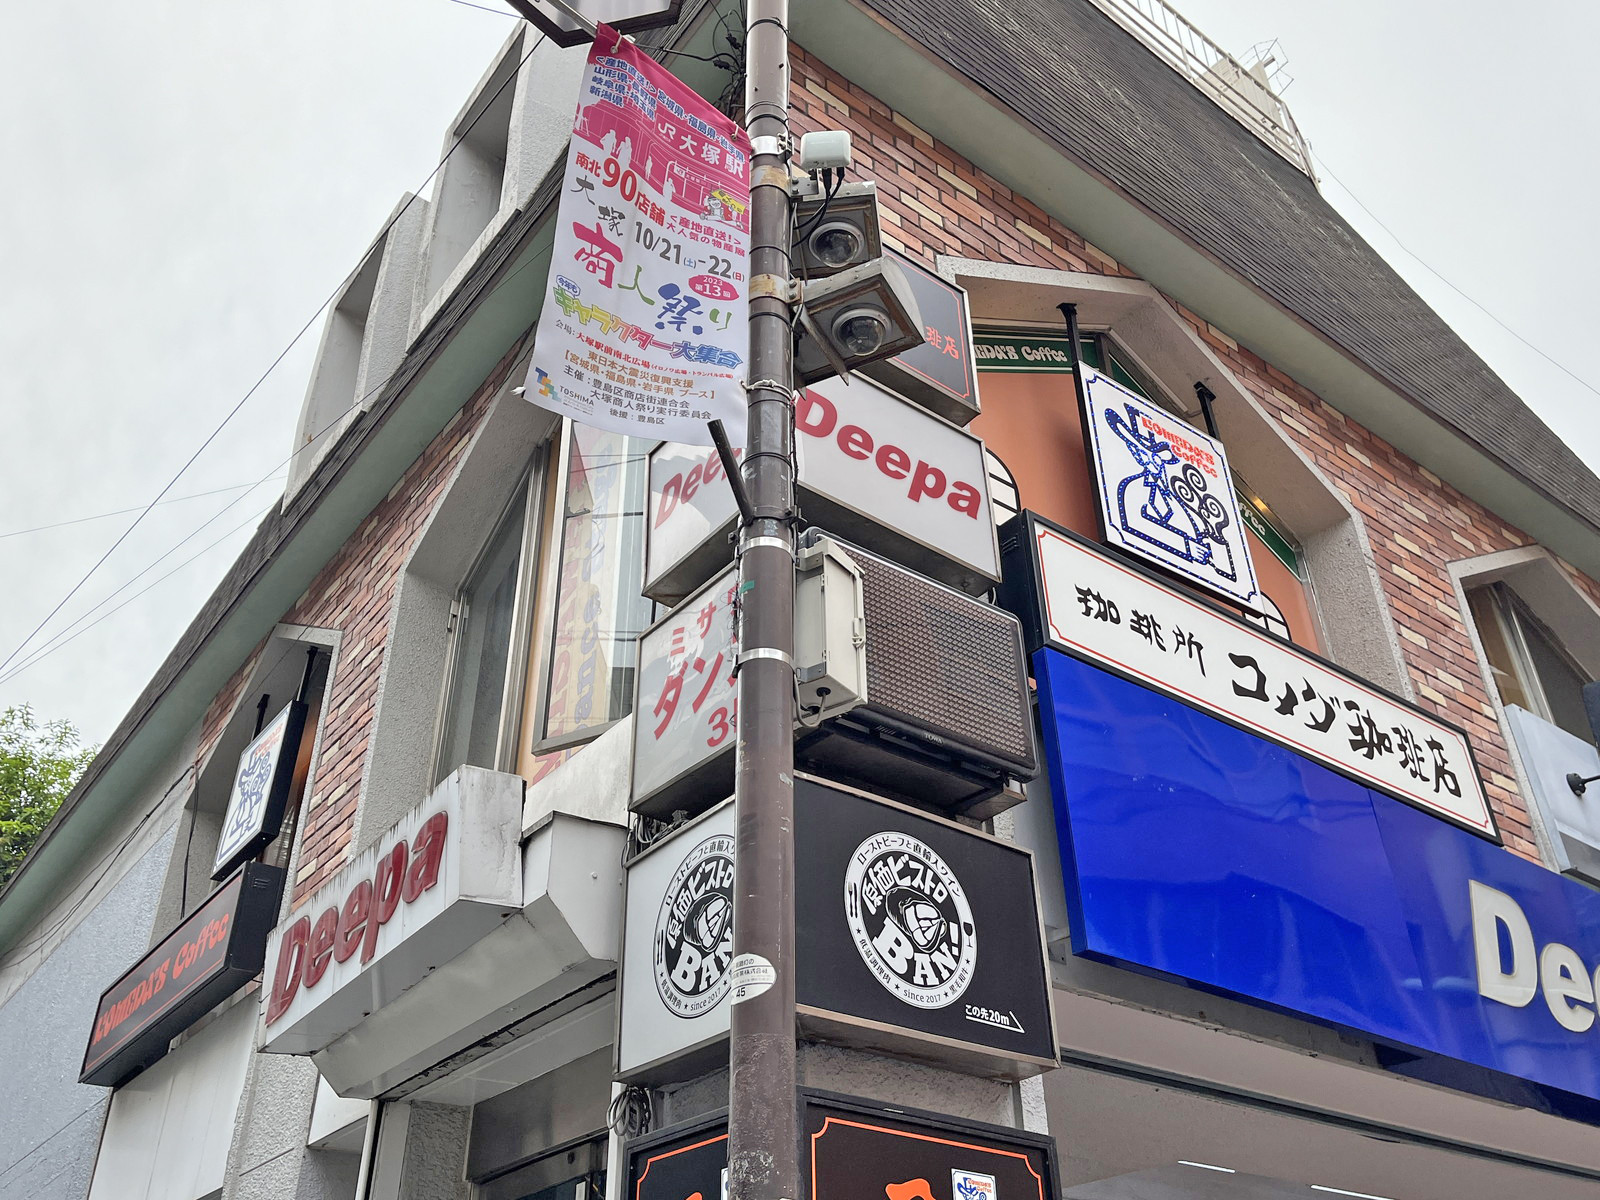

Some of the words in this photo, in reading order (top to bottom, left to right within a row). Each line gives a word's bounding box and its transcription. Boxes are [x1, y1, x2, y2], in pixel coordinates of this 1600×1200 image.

[679, 135, 744, 179] 大塚駅
[667, 222, 745, 257] 大人気の物産展
[703, 276, 723, 286] 2023
[553, 286, 744, 369] キャラクター大集合
[587, 350, 694, 389] 東日本大震災復興支援
[559, 385, 595, 406] TOSHIMA
[590, 389, 712, 420] 大塚商人祭り実行委員会
[795, 387, 982, 521] Deepa
[1171, 444, 1218, 478] Coffee
[1074, 583, 1208, 678] 珈琲所
[1227, 651, 1462, 799] コメダ珈琲店
[861, 853, 949, 916] 原価ビストロ
[265, 810, 449, 1027] Deepa
[172, 913, 229, 980] Coffee
[1468, 879, 1600, 1033] De
[690, 1000, 707, 1012] since
[707, 987, 721, 1004] 2017
[736, 986, 746, 998] 45
[903, 989, 925, 1003] since
[926, 994, 941, 1003] 2017
[965, 1004, 1010, 1026] この先20m
